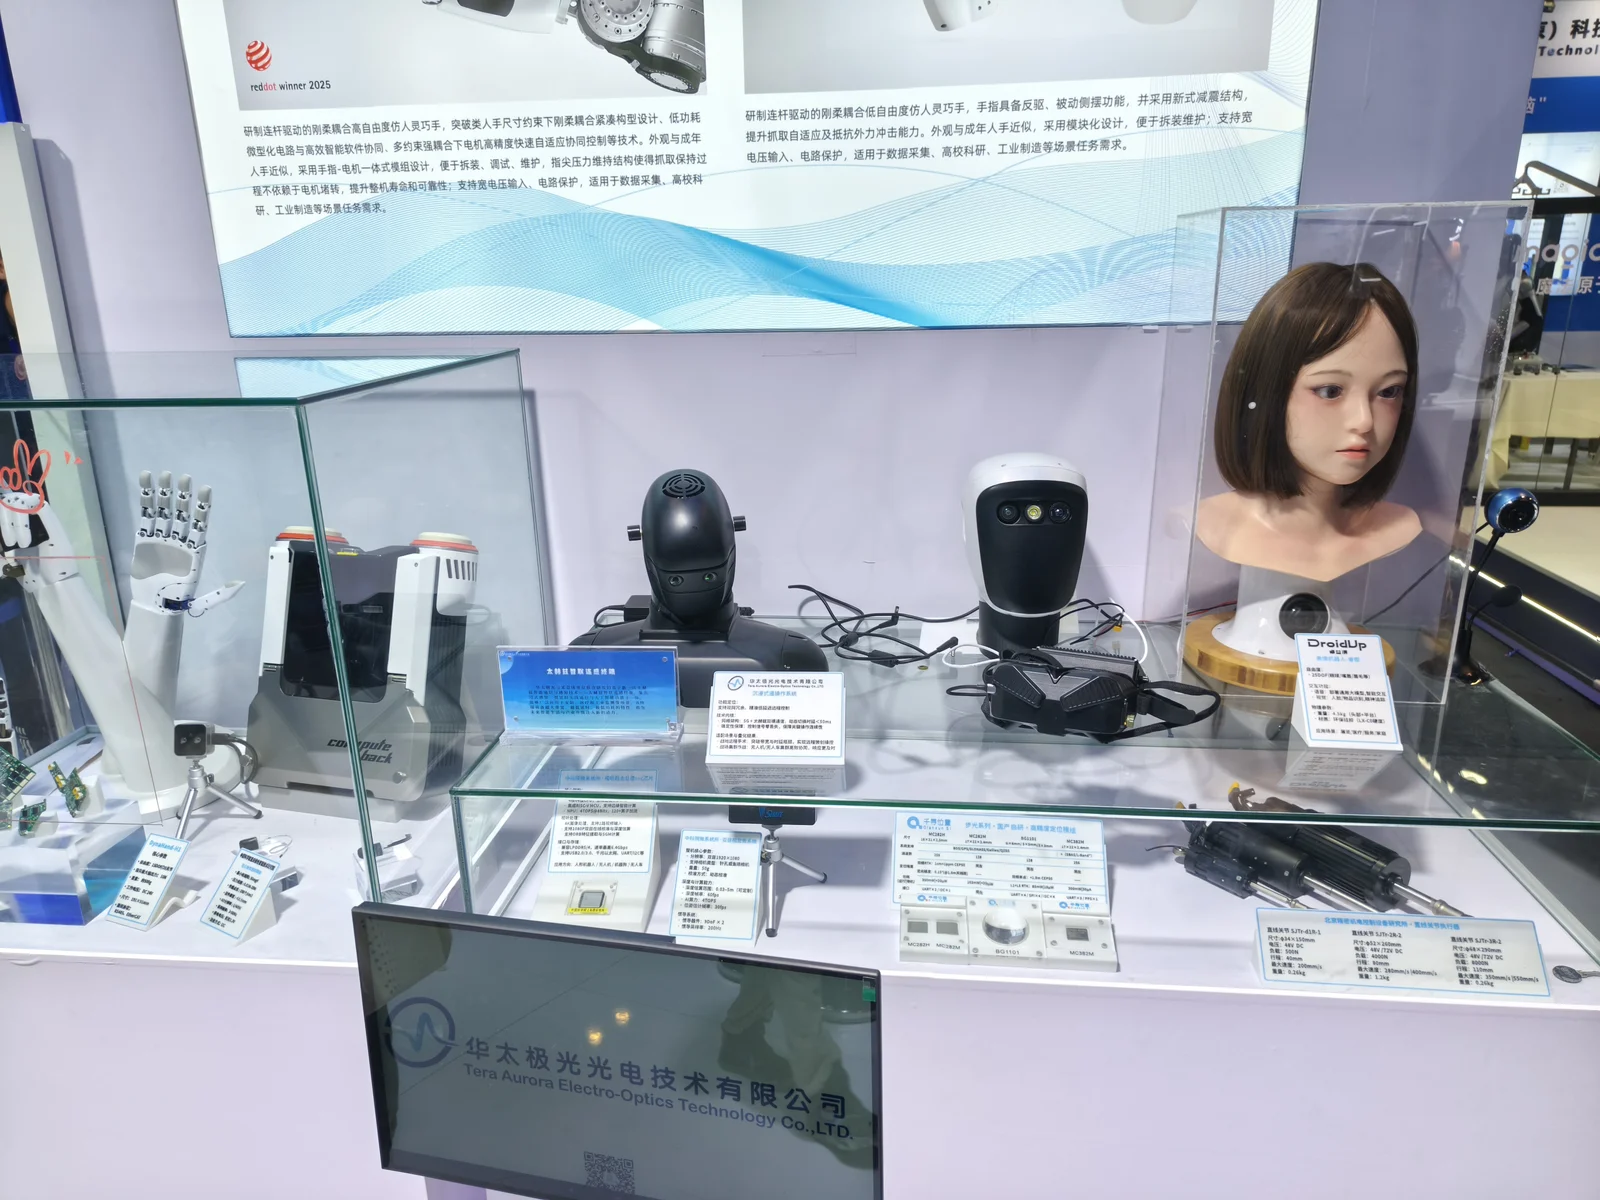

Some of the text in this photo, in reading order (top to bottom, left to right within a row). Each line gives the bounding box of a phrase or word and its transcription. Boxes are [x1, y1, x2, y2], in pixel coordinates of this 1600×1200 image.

[250, 80, 332, 92] reddot winner 2025
[1308, 638, 1367, 651] DroidUp
[465, 1036, 846, 1119] 华太极光光电技术有限公司
[463, 1063, 854, 1140] Tera Aurora Electro-Optics Technology Co.,LTD.
